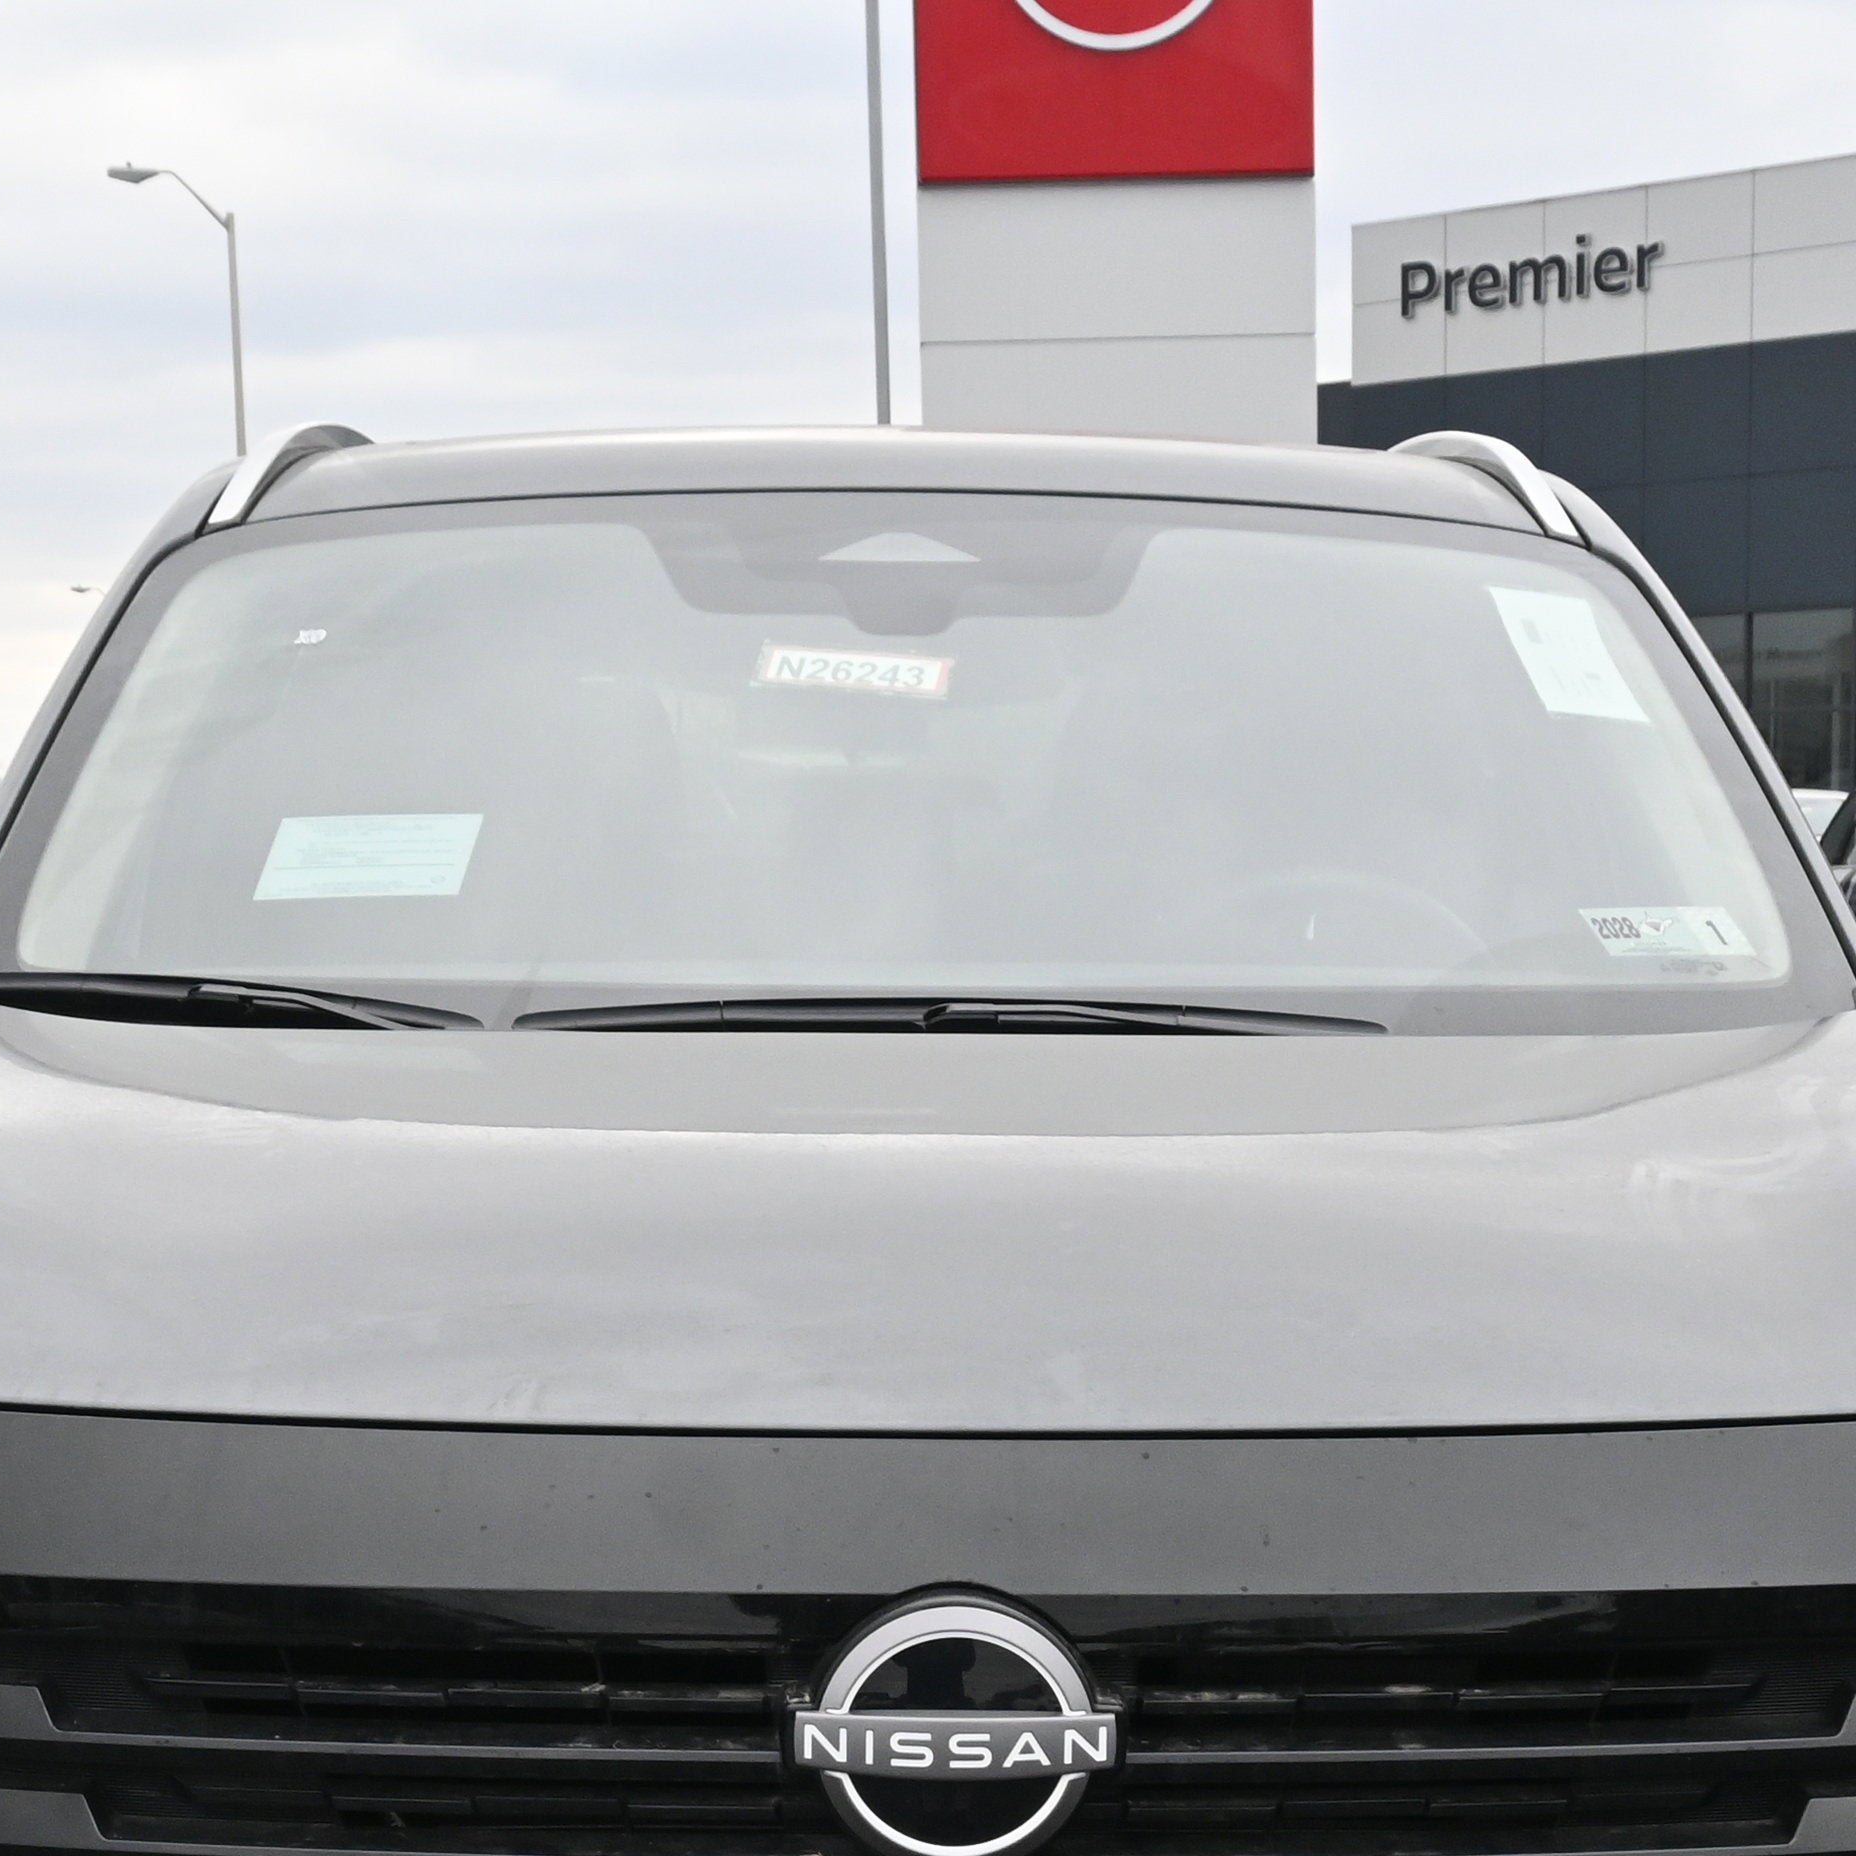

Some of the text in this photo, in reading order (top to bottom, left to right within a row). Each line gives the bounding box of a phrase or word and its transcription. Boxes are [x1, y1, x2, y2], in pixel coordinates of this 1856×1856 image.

[1400, 233, 1663, 318] Premier
[775, 655, 926, 689] N26243
[1590, 916, 1728, 946] 2028 1
[803, 1723, 1108, 1769] NISSAN
